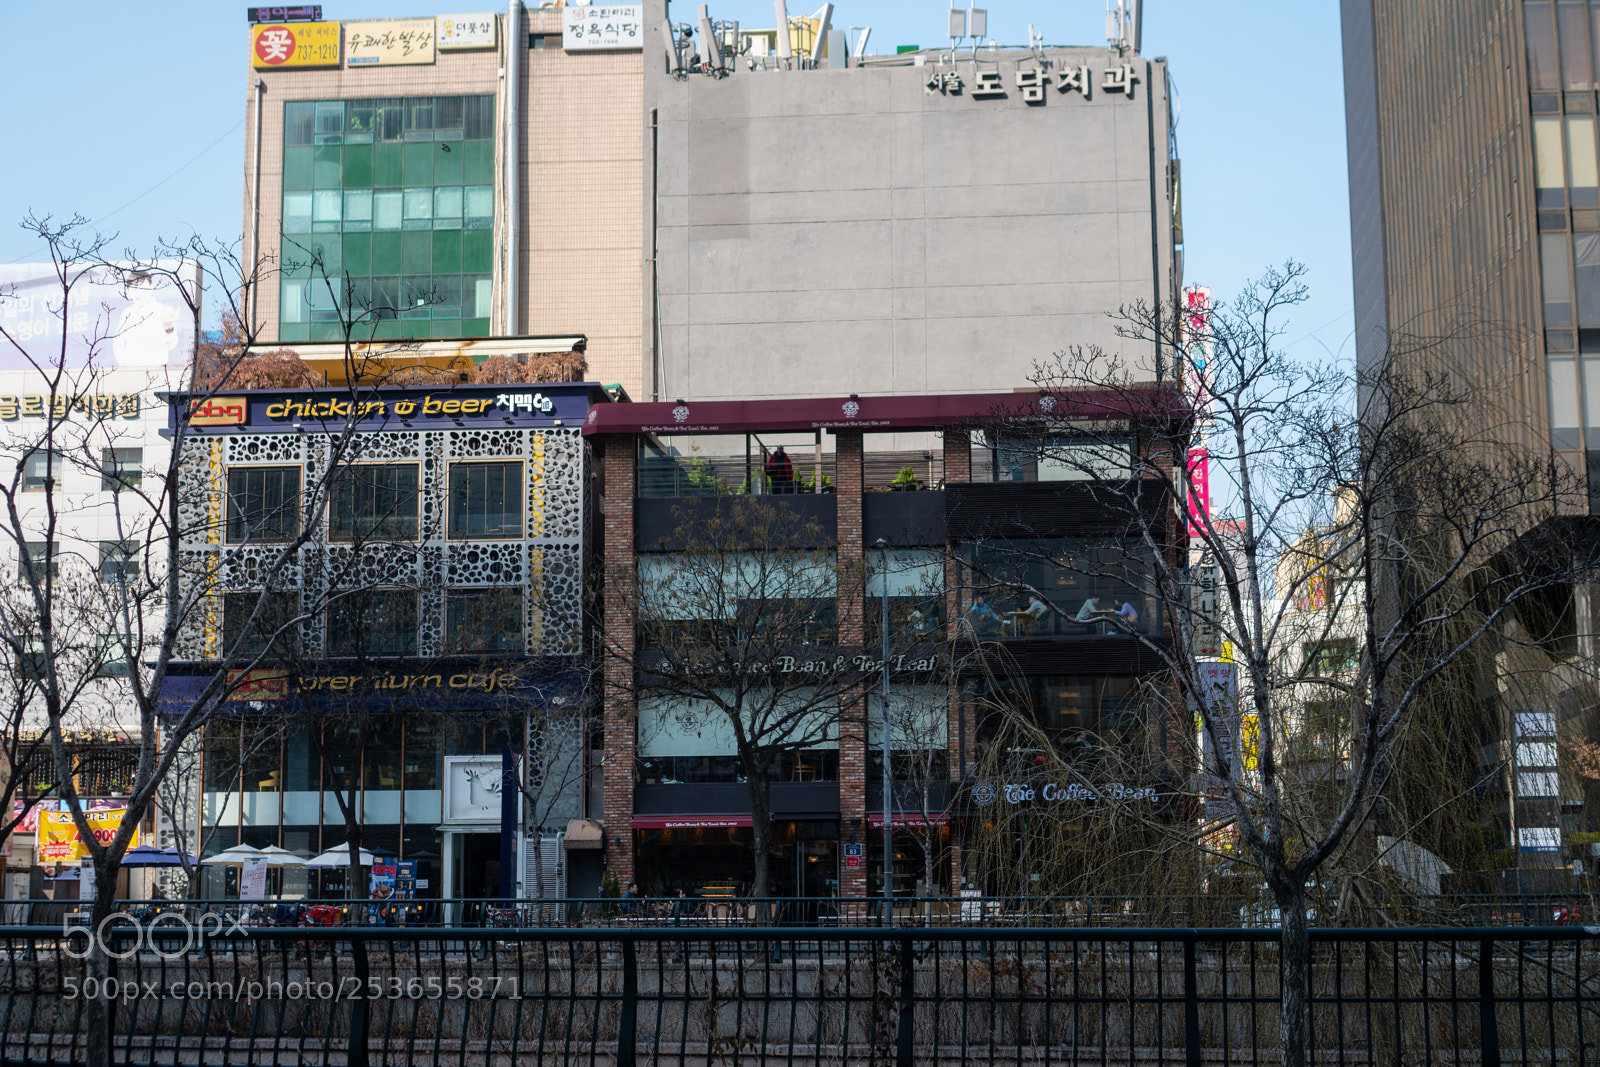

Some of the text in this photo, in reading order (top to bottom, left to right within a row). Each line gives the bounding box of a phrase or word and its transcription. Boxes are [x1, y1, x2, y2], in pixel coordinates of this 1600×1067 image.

[456, 22, 491, 34] 더풋샵
[569, 23, 640, 38] 정육식당
[260, 30, 292, 61] 꽃
[297, 44, 338, 60] 737-1210
[926, 64, 1138, 101] 서울 도담치과
[265, 397, 385, 418] chicken
[422, 396, 493, 415] beer
[776, 656, 829, 675] Bean
[1004, 783, 1035, 804] The
[1042, 783, 1097, 801] Coffee
